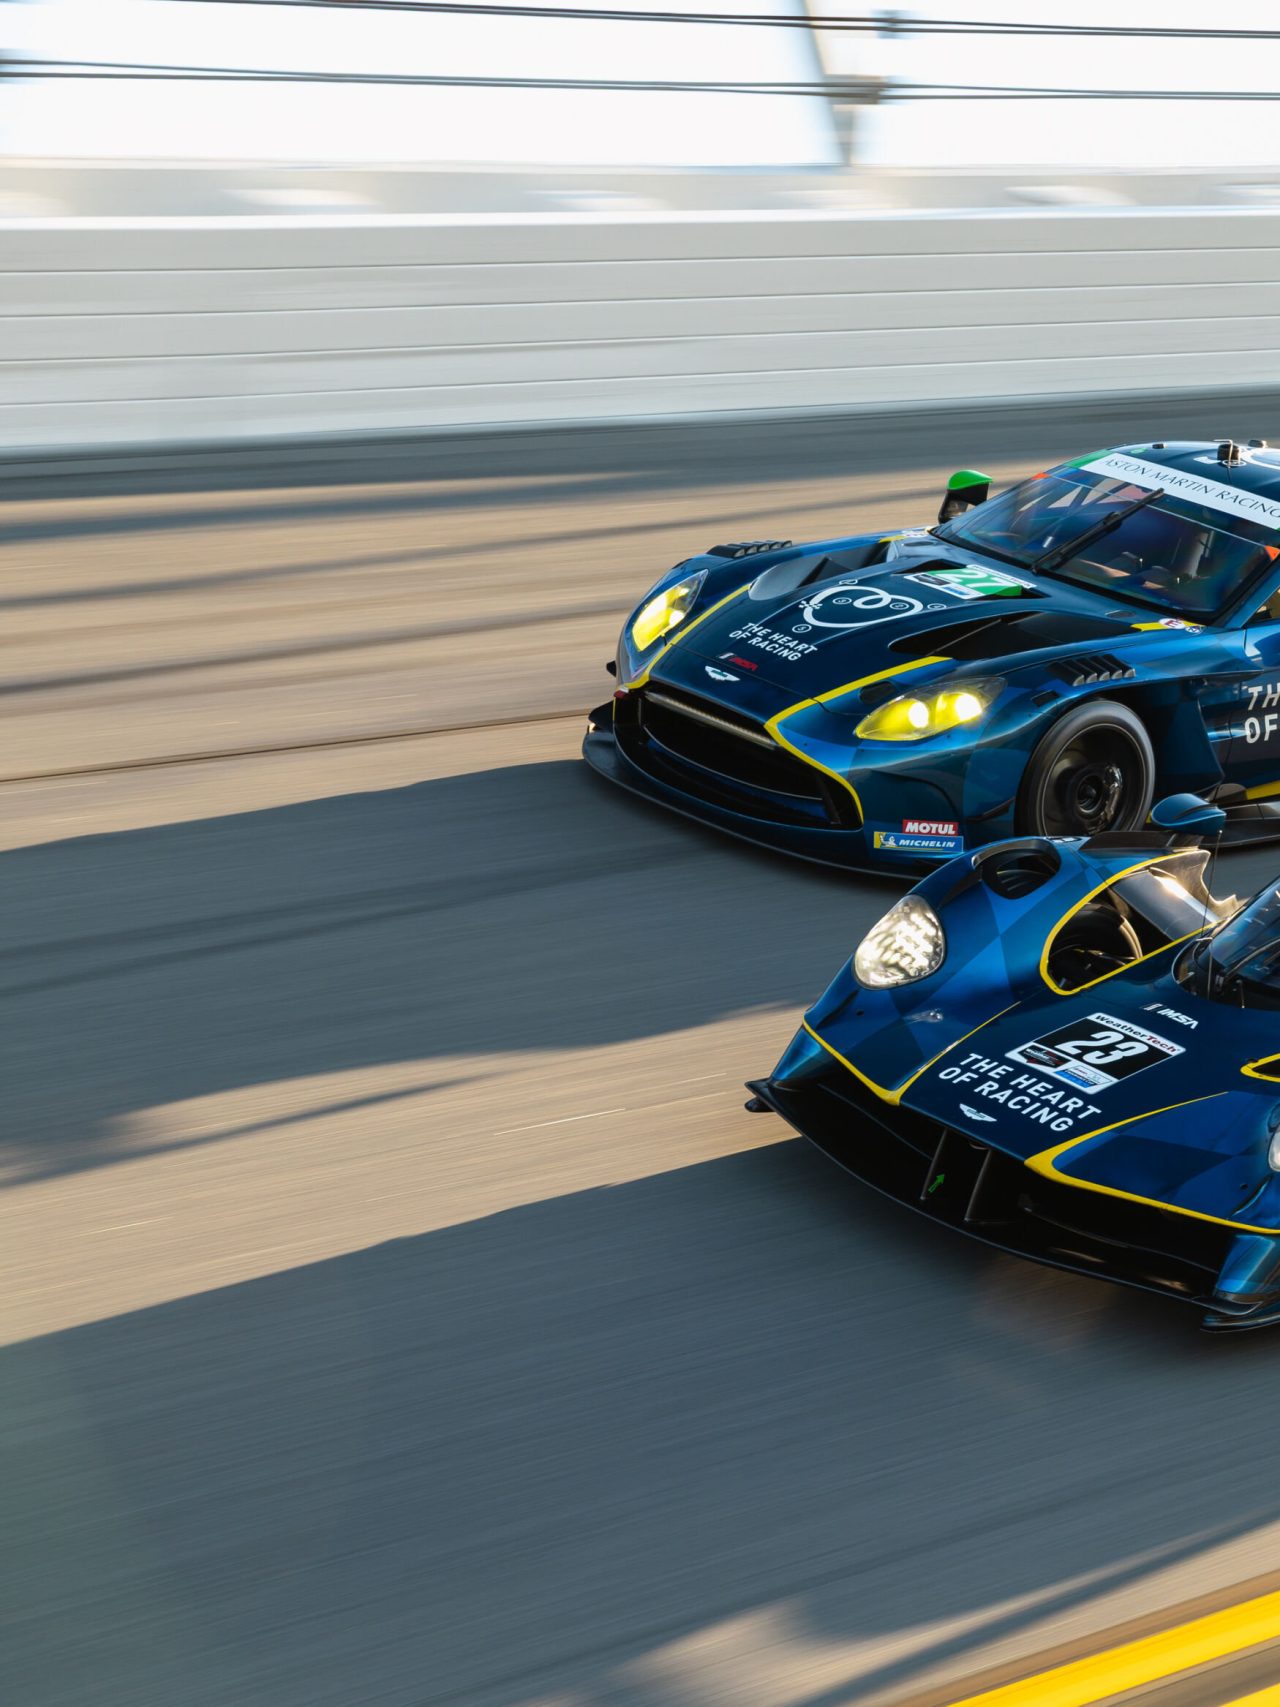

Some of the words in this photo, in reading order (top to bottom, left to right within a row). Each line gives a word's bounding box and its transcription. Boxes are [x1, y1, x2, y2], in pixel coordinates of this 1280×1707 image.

[1104, 458, 1153, 477] ASTON
[1149, 471, 1216, 495] MARTIN
[729, 630, 751, 640] OF
[748, 636, 802, 661] RACING
[742, 622, 772, 637] THE
[768, 632, 818, 654] HEART
[1244, 713, 1278, 744] OF
[898, 839, 956, 848] MICHELIN
[905, 822, 956, 835] MOTUL
[1095, 1014, 1181, 1053] WeatherTech
[1156, 1008, 1199, 1029] IMSA
[1054, 1030, 1149, 1065] 23
[938, 1067, 979, 1084] OF
[974, 1080, 1074, 1132] RACING
[959, 1053, 1014, 1079] THE
[1010, 1073, 1103, 1120] HEART
